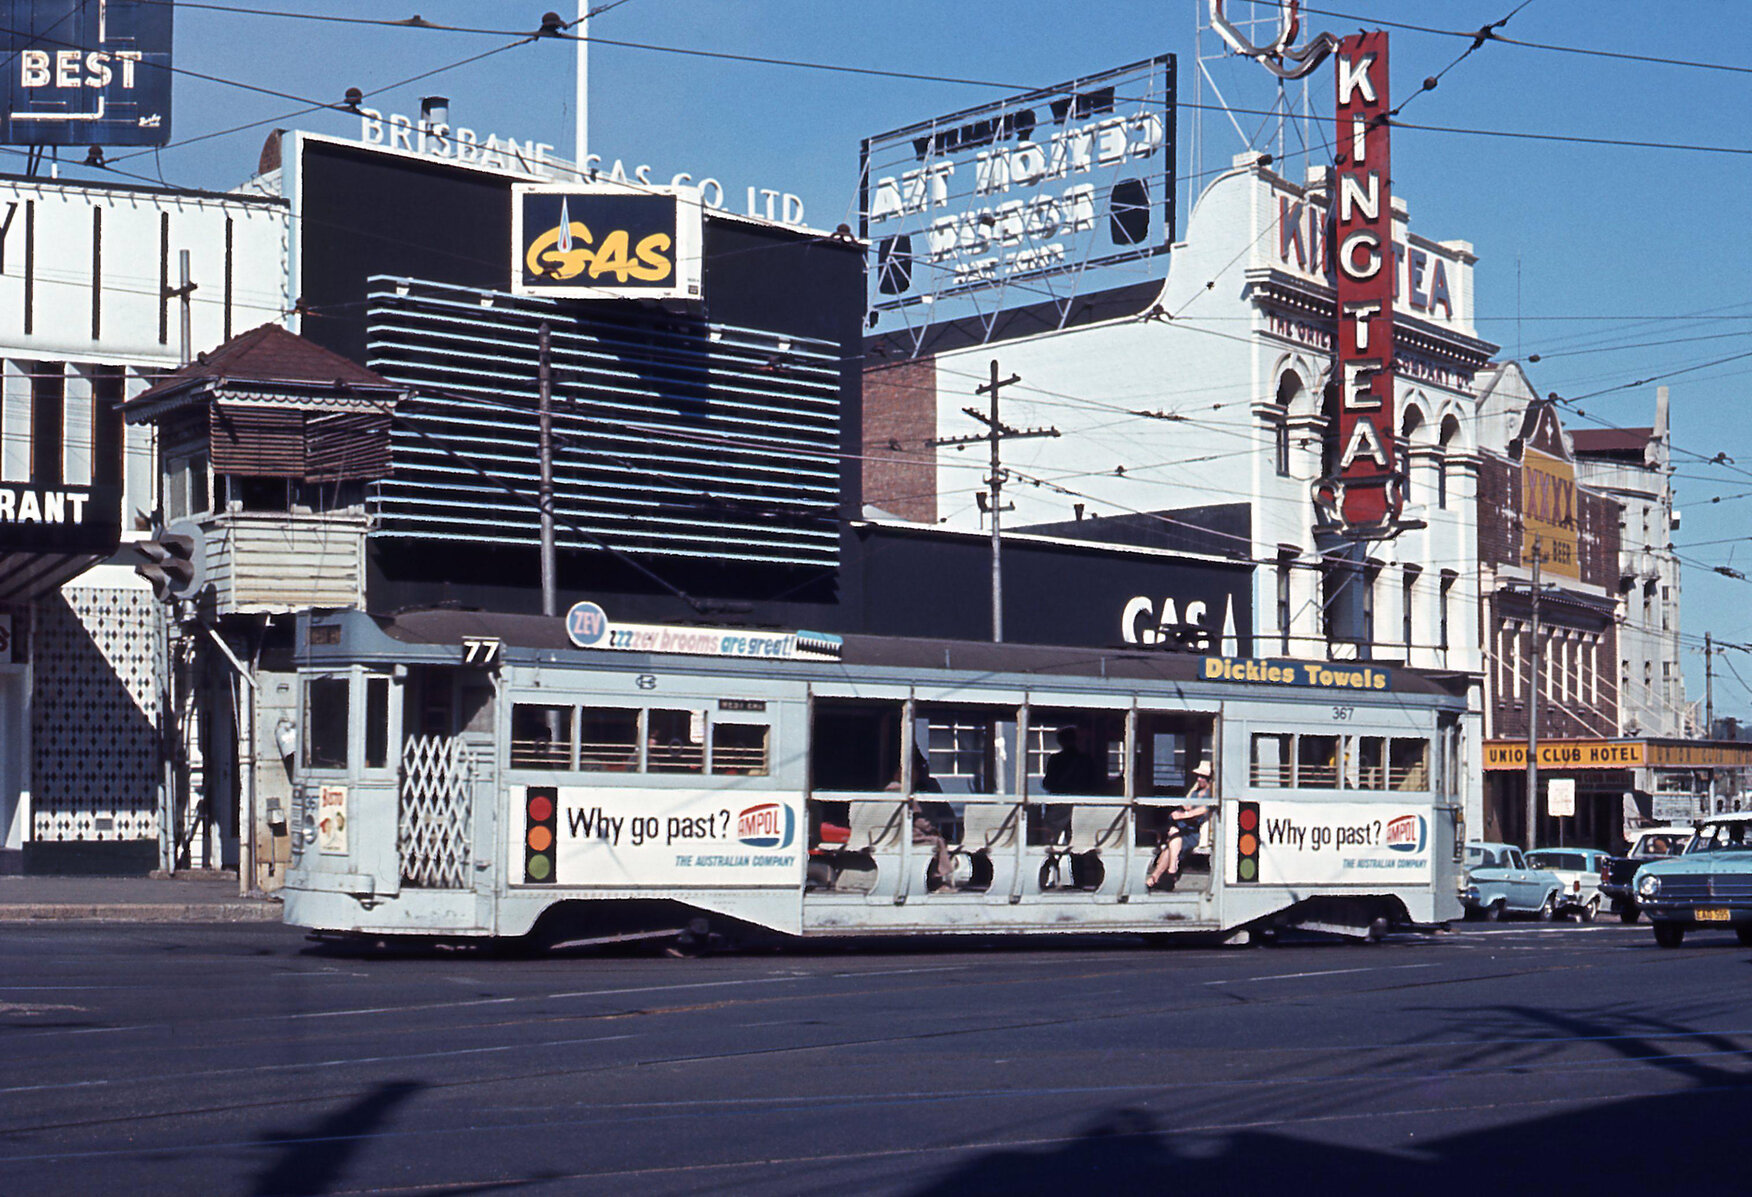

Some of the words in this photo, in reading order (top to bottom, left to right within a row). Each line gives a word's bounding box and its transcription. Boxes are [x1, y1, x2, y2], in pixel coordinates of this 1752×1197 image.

[21, 50, 142, 88] BEST
[361, 108, 554, 177] BRISBANE
[583, 154, 652, 185] GAS
[747, 186, 808, 229] LTD.
[1339, 53, 1382, 279] KING
[526, 221, 672, 283] GAS
[1279, 195, 1328, 277] KI
[1392, 241, 1453, 322] TEA
[1341, 302, 1388, 468] TEA
[0, 488, 90, 525] RANT
[1526, 466, 1575, 532] XXXX
[573, 610, 601, 636] ZEV
[1122, 596, 1209, 650] GAS
[463, 641, 499, 663] 77
[660, 628, 719, 653] brooms
[721, 636, 747, 654] are
[748, 634, 795, 657] great!
[1205, 657, 1295, 684] Dickies
[1304, 665, 1386, 689] Towels
[1332, 707, 1354, 720] 367
[1542, 748, 1582, 762] CLUB
[1590, 747, 1639, 762] HOTEL
[567, 807, 624, 847] Why
[631, 816, 659, 846] go
[667, 809, 730, 846] past?
[738, 810, 780, 837] AMPOL
[1267, 818, 1306, 852] Why
[1311, 826, 1331, 851] go
[1336, 820, 1381, 851] past?
[1386, 820, 1416, 844] AMPOL
[676, 855, 693, 867] THE
[695, 855, 750, 867] AUSTRALIAN
[752, 855, 795, 867] COMPANY
[1343, 858, 1356, 869] THE
